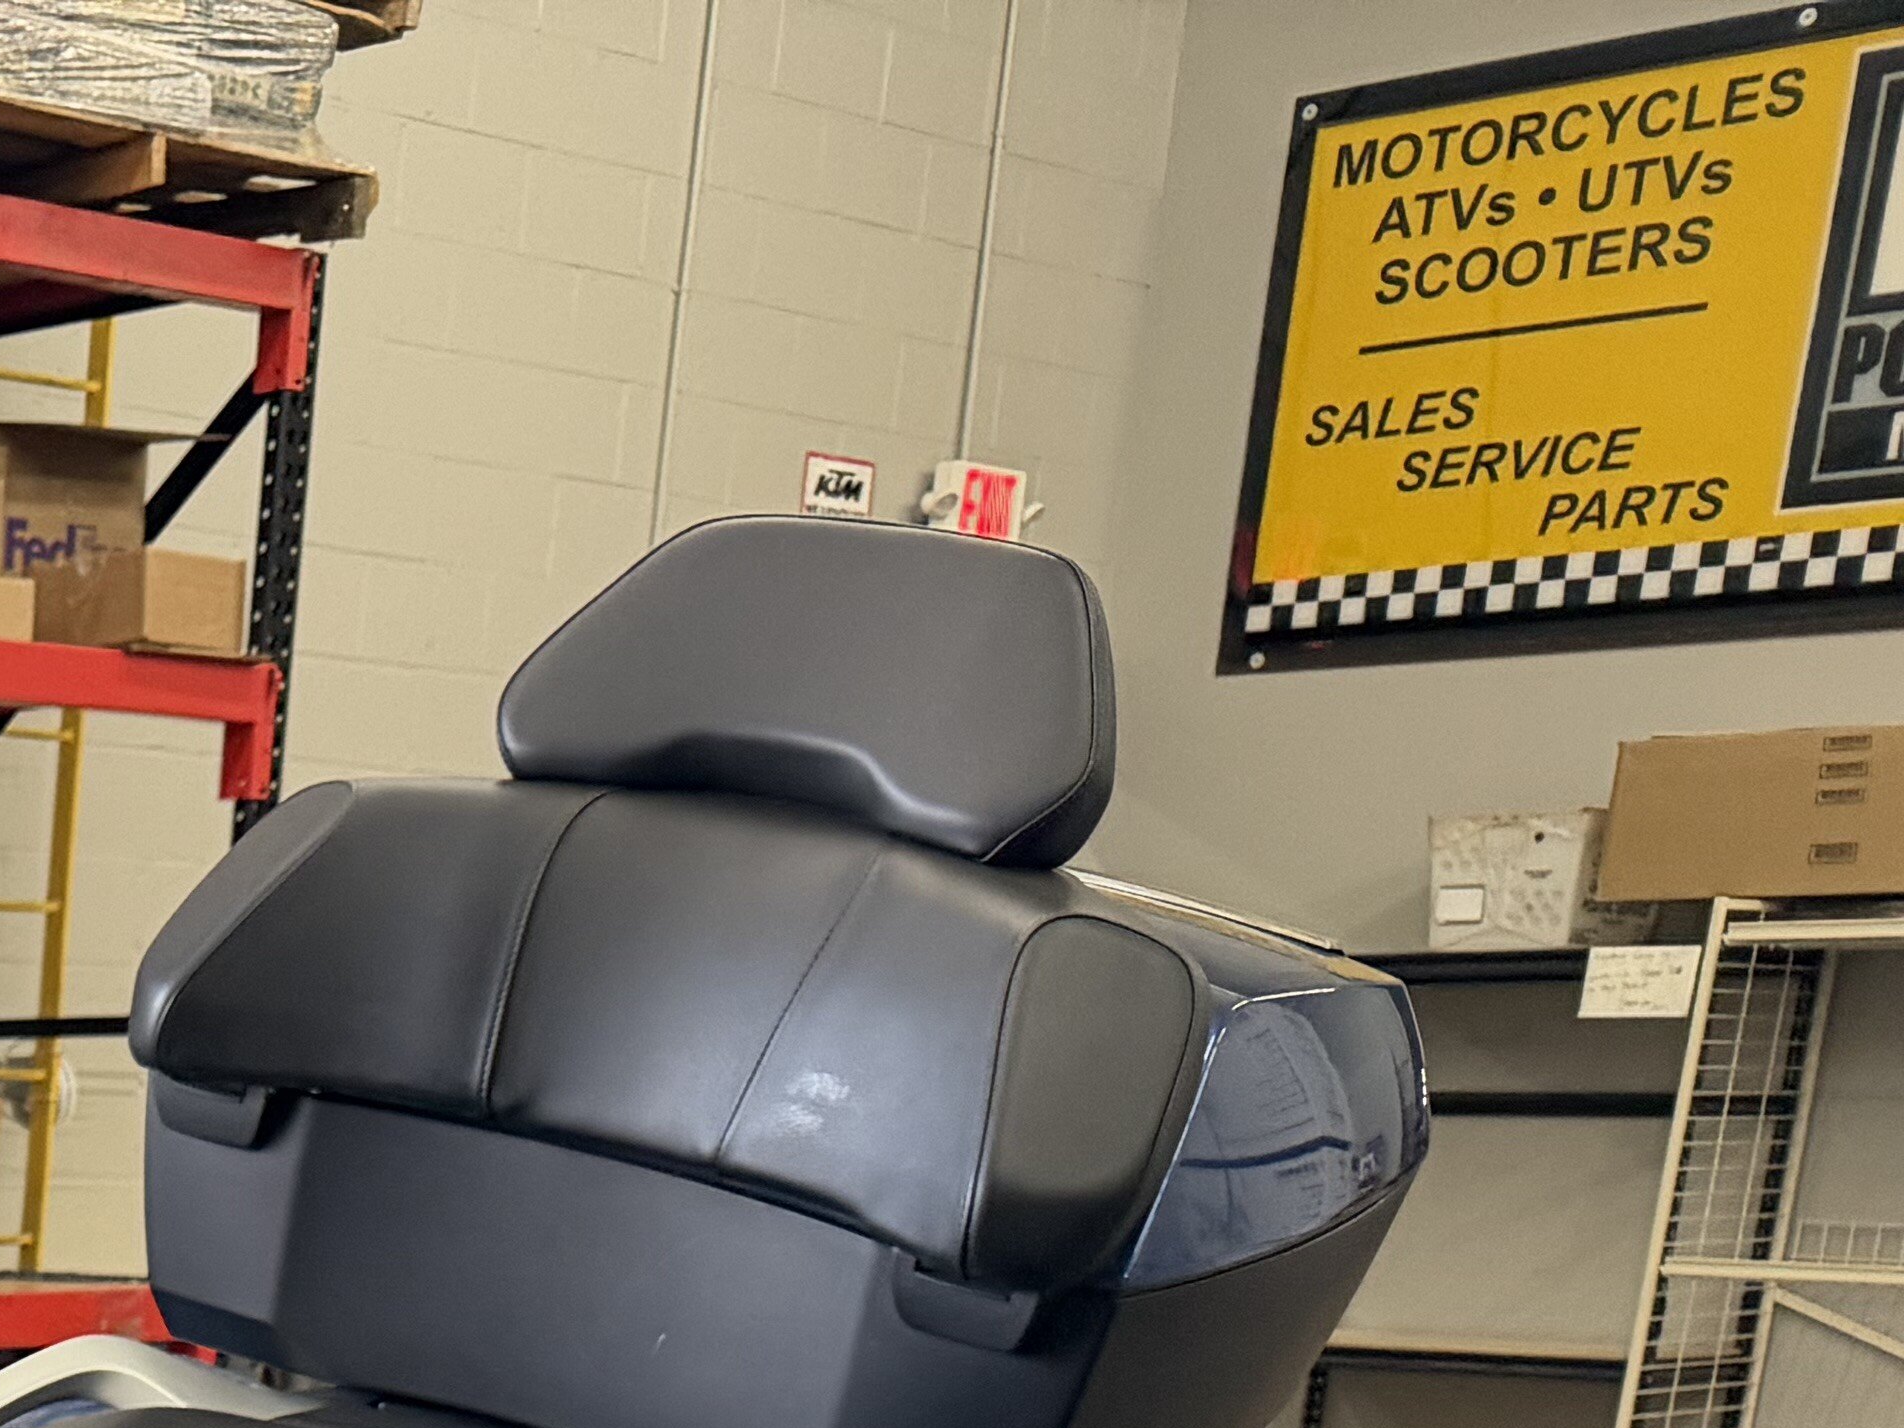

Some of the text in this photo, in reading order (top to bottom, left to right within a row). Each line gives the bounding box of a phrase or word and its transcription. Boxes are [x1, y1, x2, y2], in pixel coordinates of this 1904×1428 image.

[1332, 67, 1808, 188] MOTORCYCLES
[1372, 151, 1734, 243] ATVs UTVs
[1374, 217, 1714, 305] SCOOTERS
[1304, 387, 1480, 447] SALES
[814, 469, 863, 503] KTM
[1395, 427, 1641, 492] SERVICE
[1537, 478, 1729, 536] PARTS
